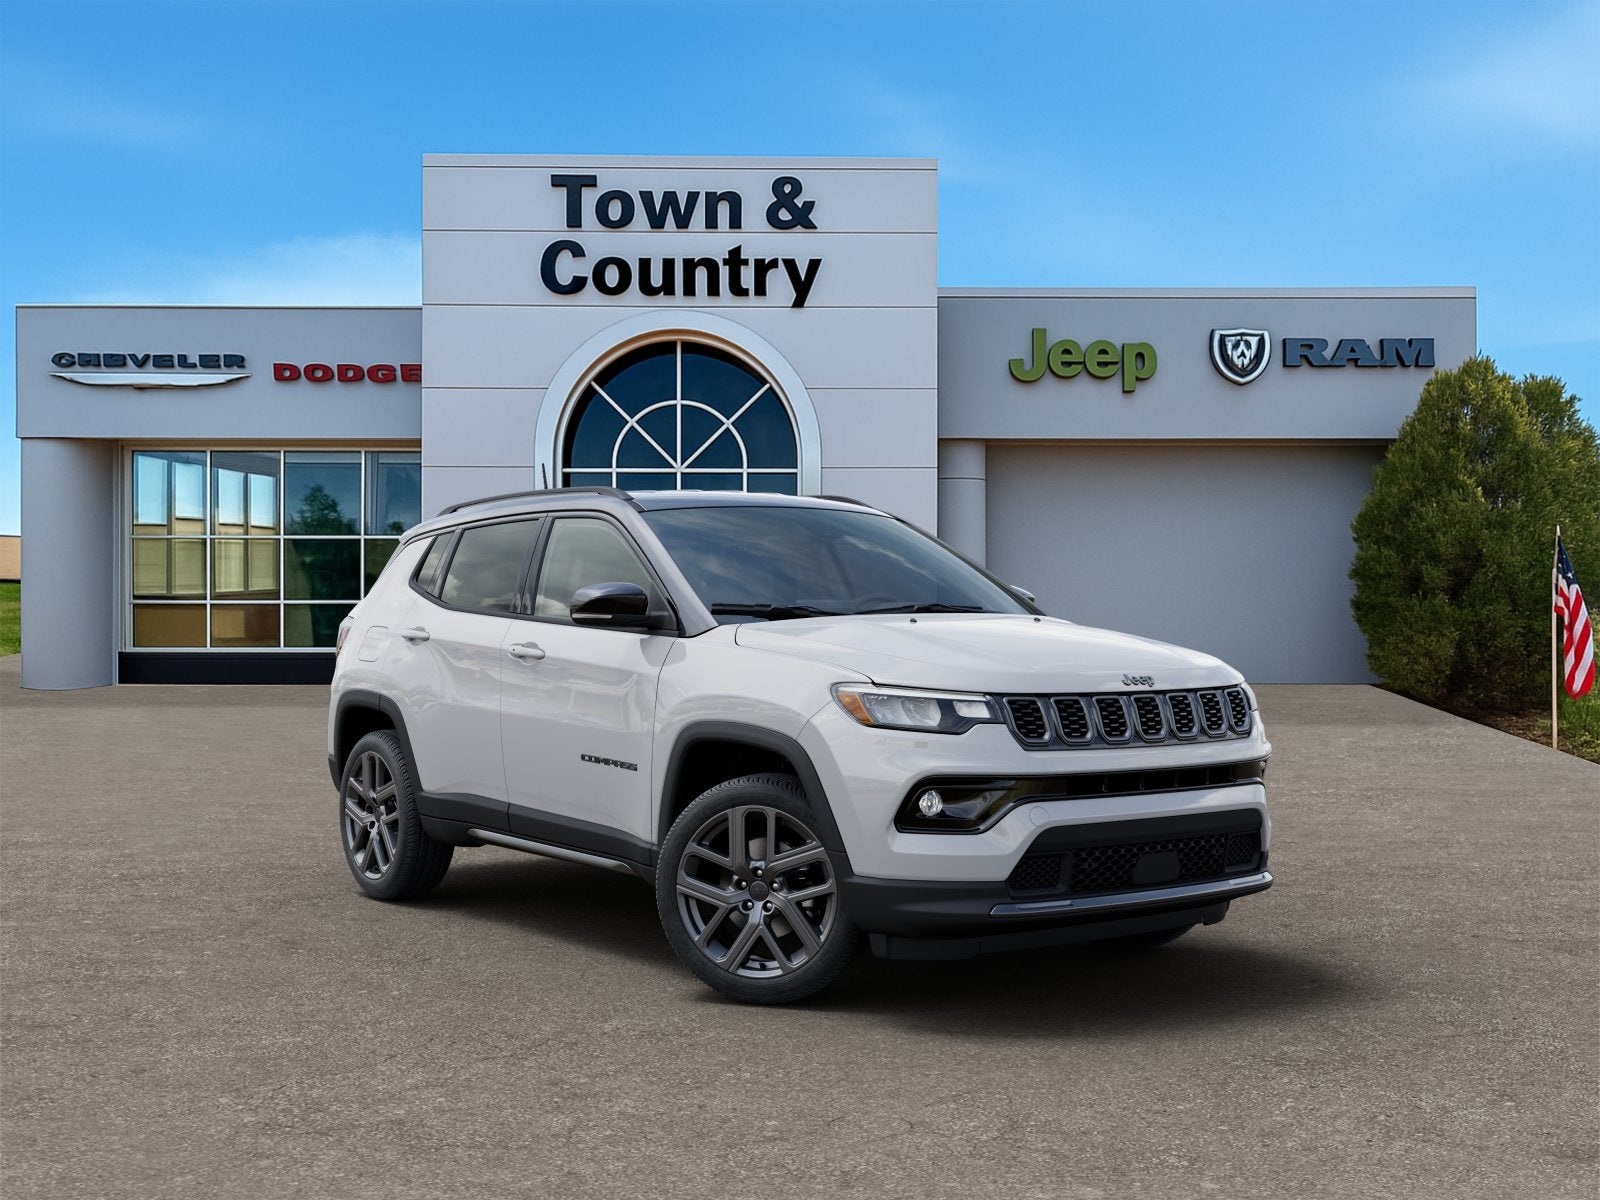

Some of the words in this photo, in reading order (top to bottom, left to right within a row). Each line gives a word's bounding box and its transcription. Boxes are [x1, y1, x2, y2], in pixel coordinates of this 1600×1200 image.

[550, 174, 742, 230] Town
[765, 176, 818, 230] &
[540, 239, 823, 308] Country
[1009, 328, 1158, 393] Jeep
[1283, 338, 1435, 368] RAM
[273, 362, 422, 383] DODGE
[1121, 673, 1155, 688] Jeep
[580, 753, 638, 772] COMPASS
